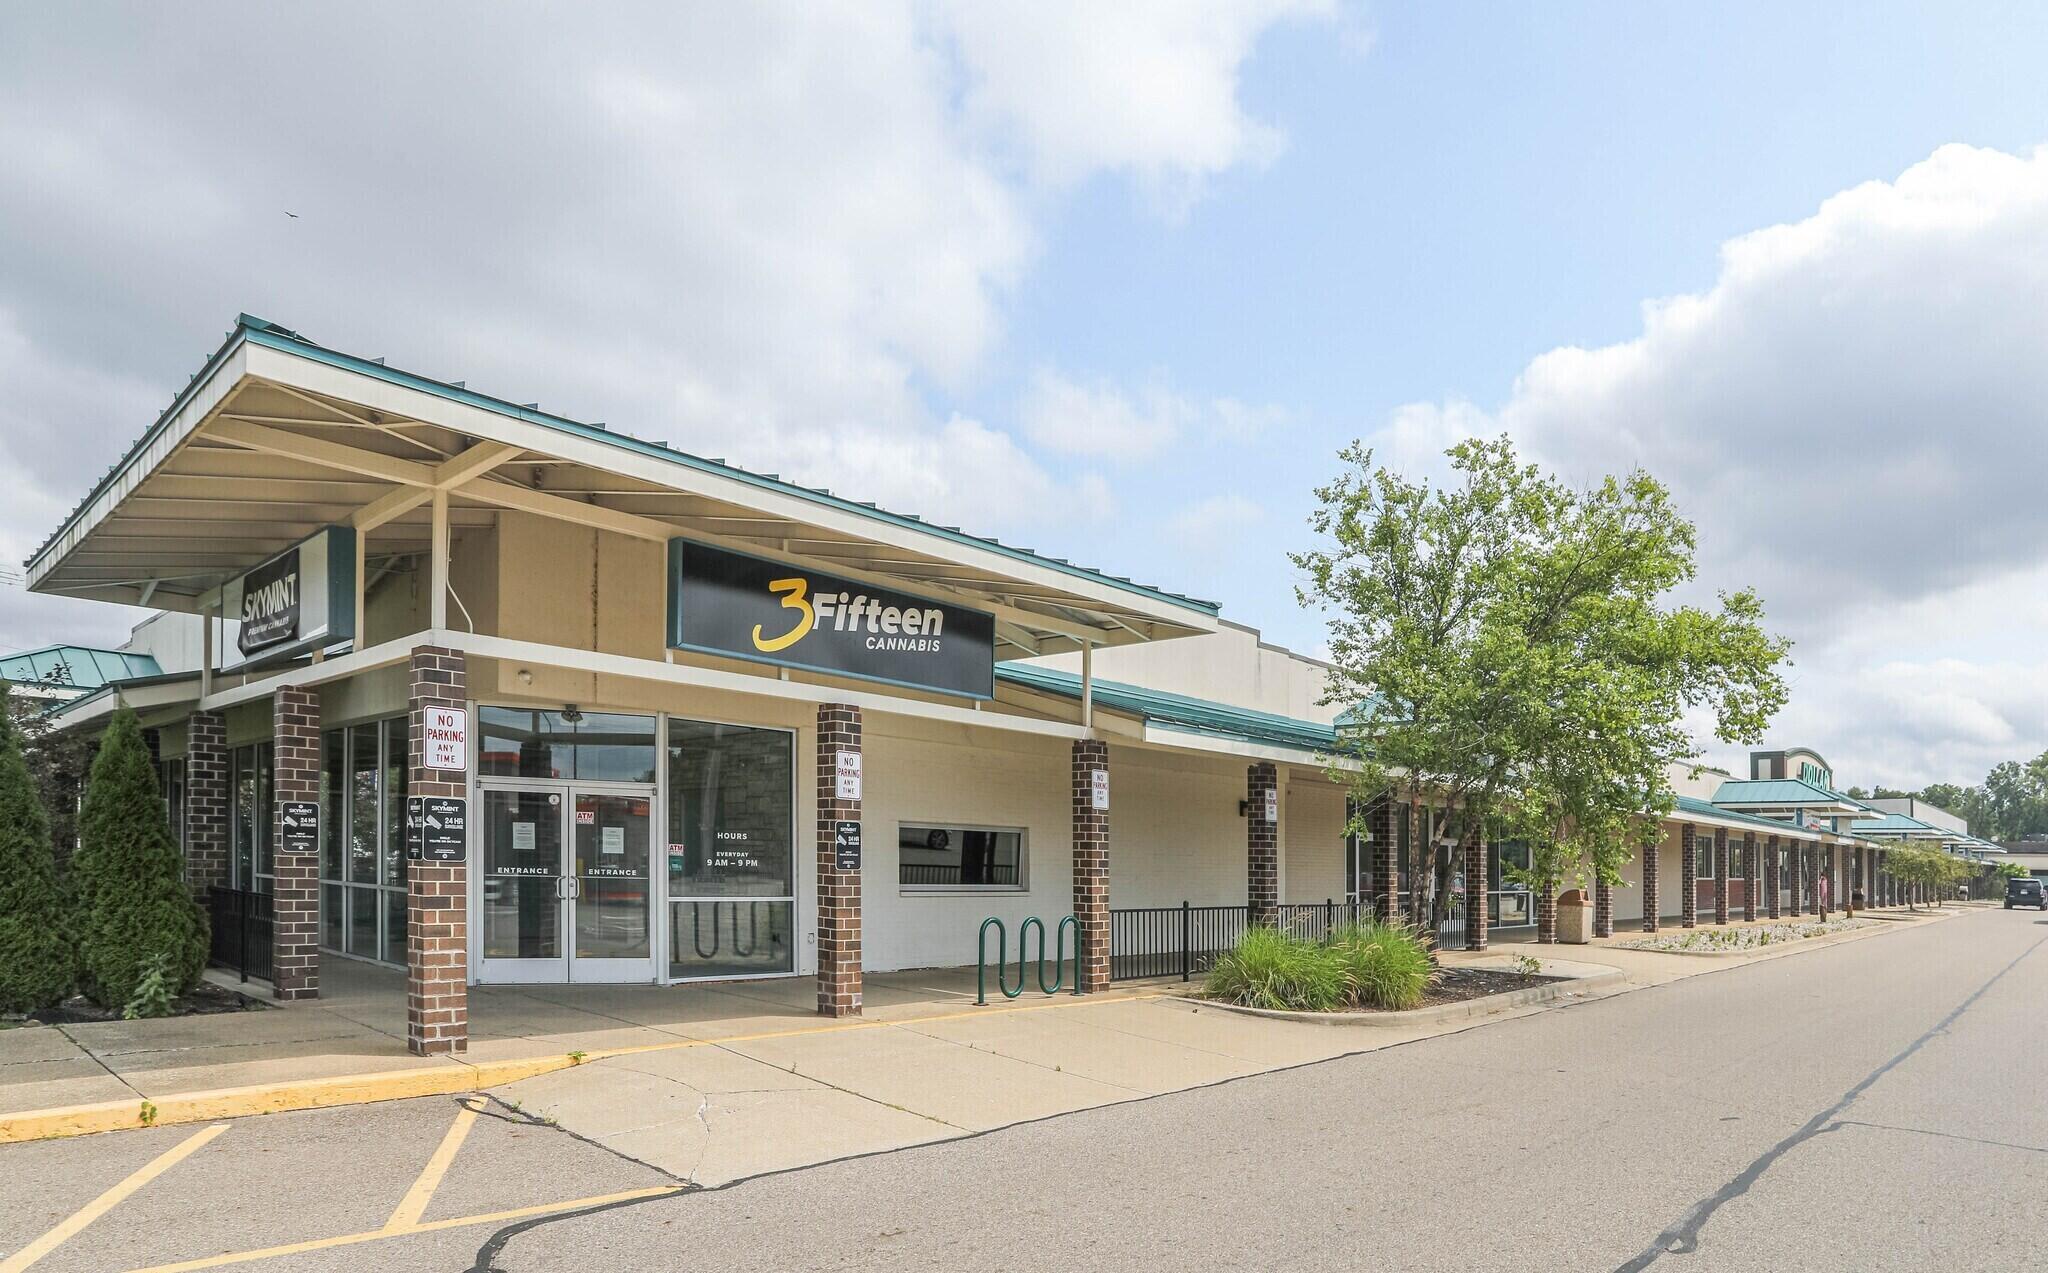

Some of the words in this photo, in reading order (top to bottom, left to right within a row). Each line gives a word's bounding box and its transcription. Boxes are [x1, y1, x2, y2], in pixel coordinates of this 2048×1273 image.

[866, 636, 940, 652] CANNABIS
[438, 715, 454, 727] NO
[427, 729, 464, 742] PARKING
[437, 744, 454, 752] ANY
[436, 754, 456, 763] TIME
[843, 757, 854, 767] NO
[837, 767, 860, 779] PARKING
[843, 779, 854, 787] ANY
[842, 787, 855, 795] TIME
[445, 817, 453, 825] 24
[454, 817, 463, 825] HR
[717, 832, 748, 840] HOURS
[738, 859, 743, 867] 9
[745, 859, 758, 867] PM
[497, 867, 549, 875] ENTRANCE
[588, 868, 637, 876] ENTRANCE
